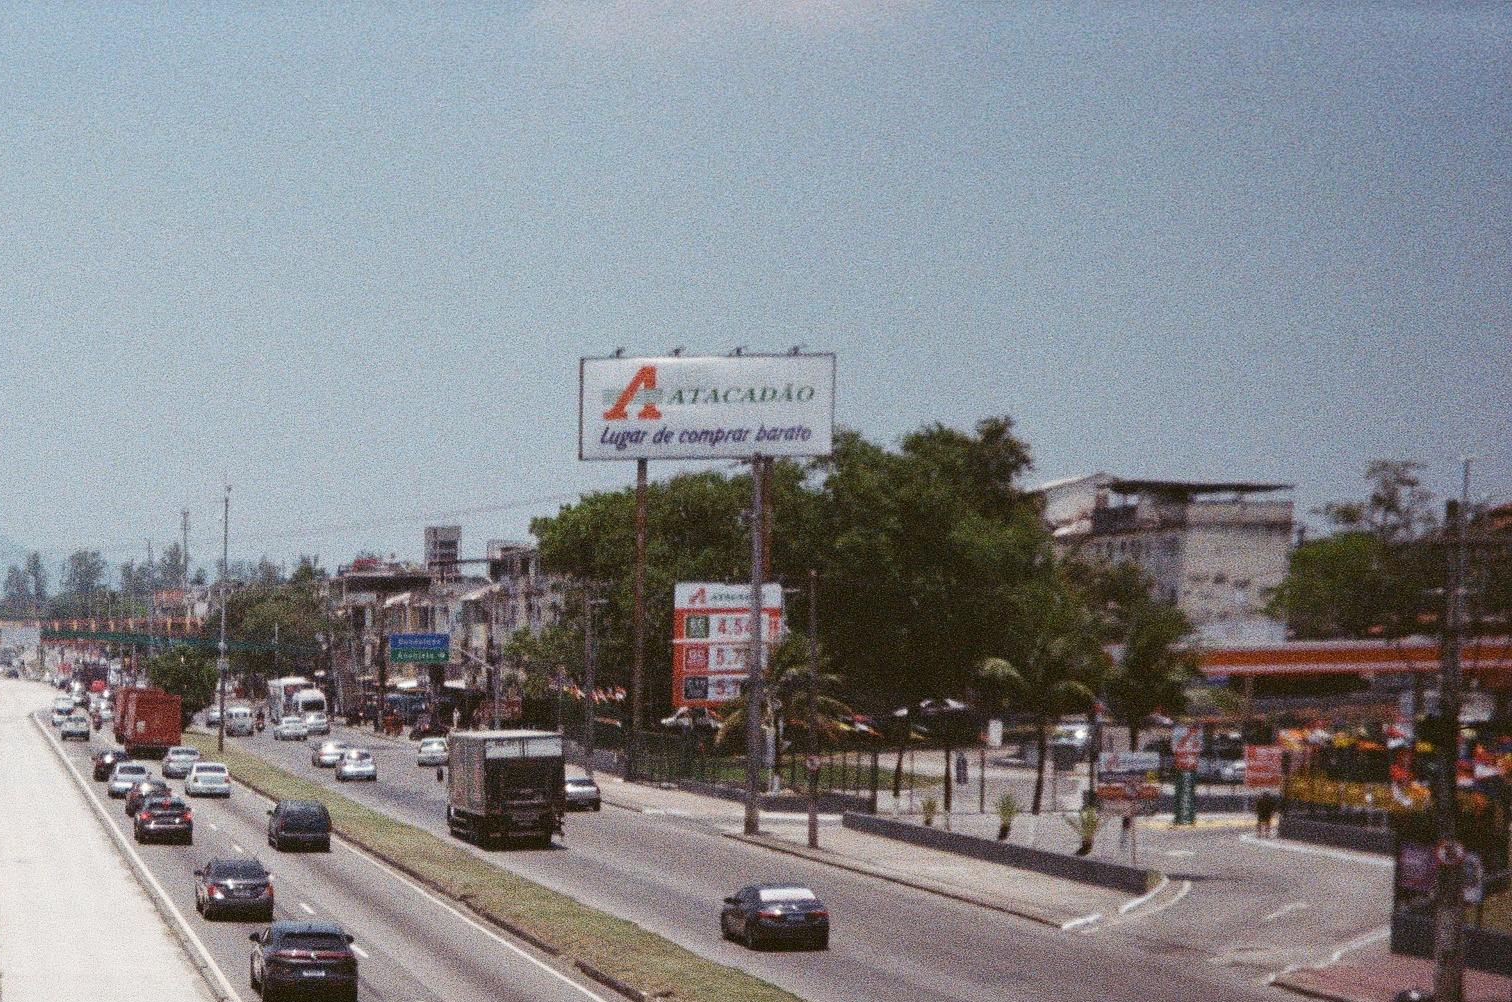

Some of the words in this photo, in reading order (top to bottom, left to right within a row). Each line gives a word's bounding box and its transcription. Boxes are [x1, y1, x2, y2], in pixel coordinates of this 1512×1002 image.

[669, 383, 816, 405] ATACADÃO
[600, 426, 648, 450] Lugar
[652, 426, 672, 444] de
[678, 428, 750, 447] comprar
[755, 423, 812, 443] barato
